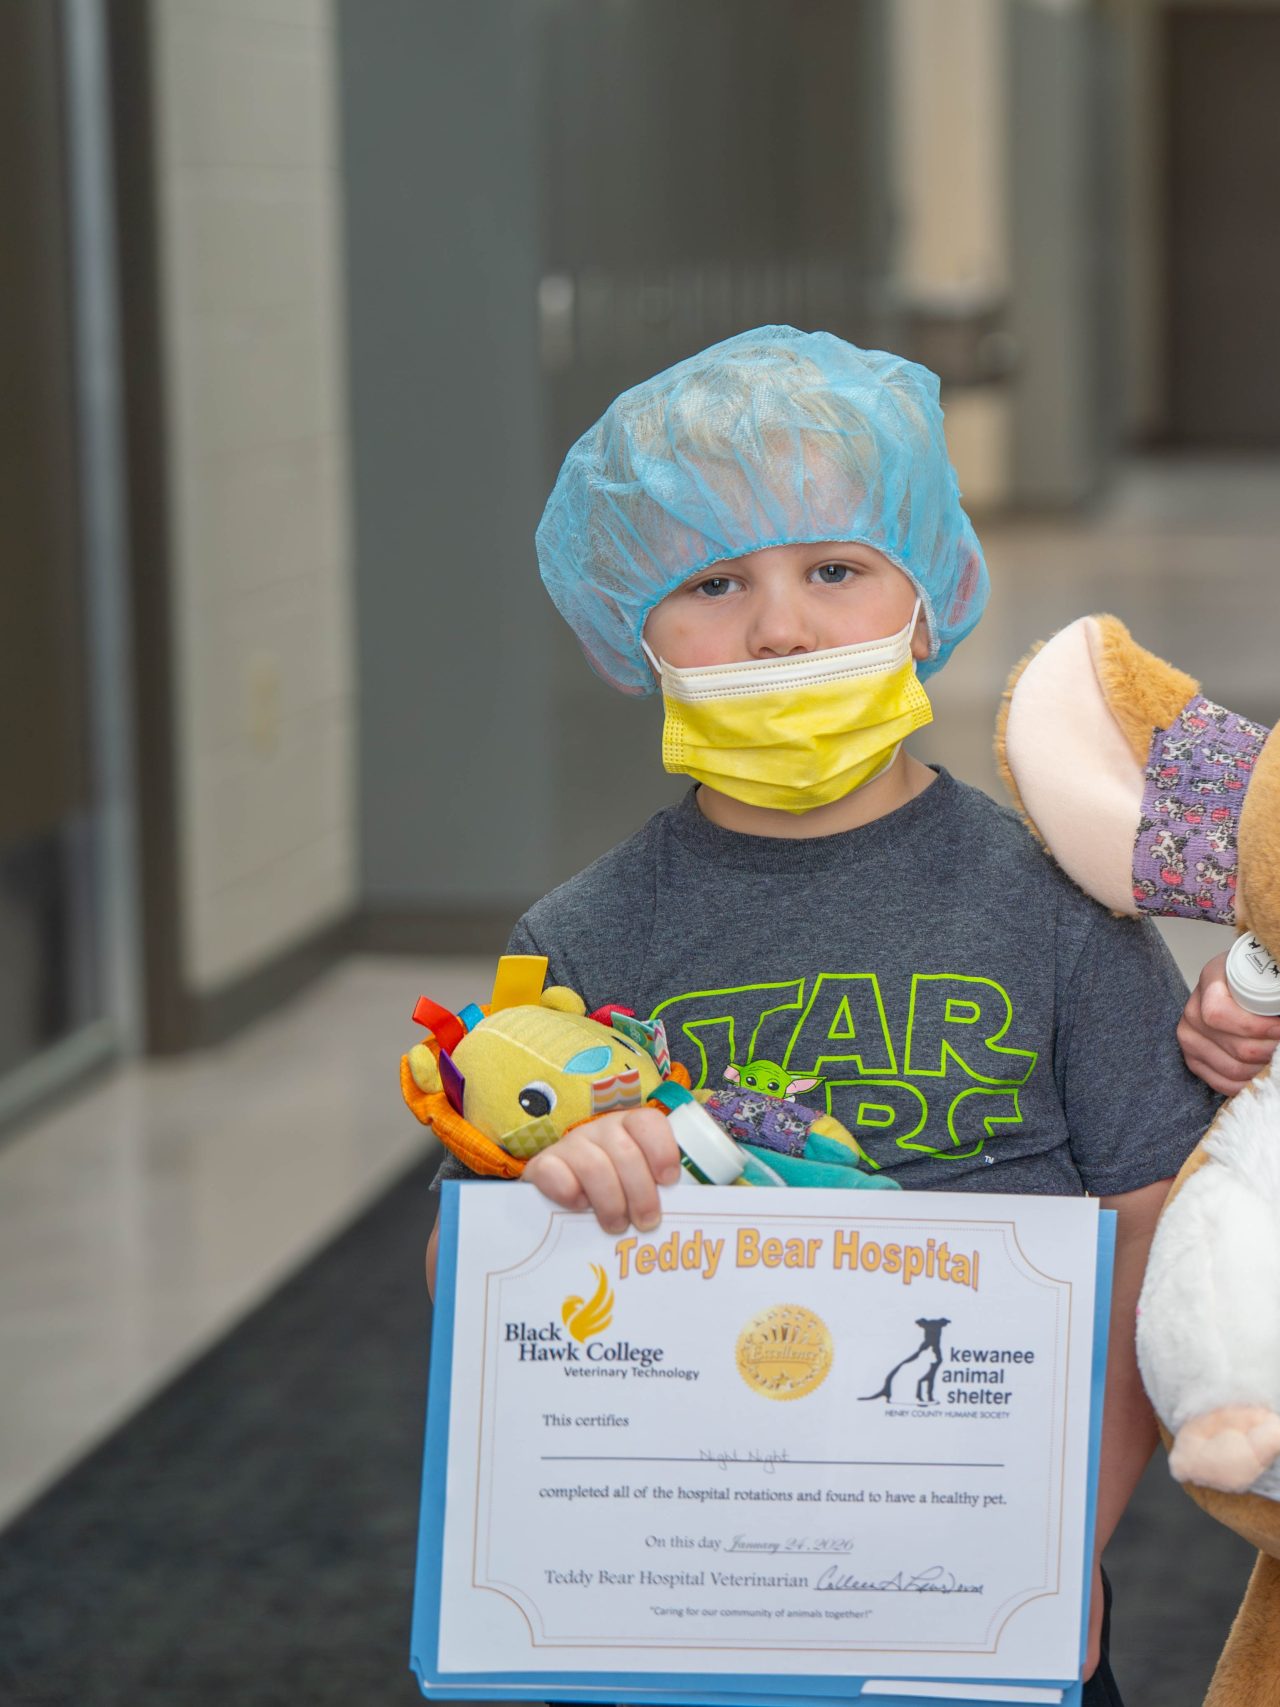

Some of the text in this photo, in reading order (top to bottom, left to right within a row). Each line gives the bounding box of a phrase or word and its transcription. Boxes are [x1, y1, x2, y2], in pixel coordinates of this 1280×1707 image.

[649, 973, 1038, 1089] STAR
[615, 1227, 980, 1292] Teddy Bear Hospital
[504, 1322, 562, 1342] Black
[518, 1342, 664, 1368] Hawk College
[950, 1347, 1035, 1364] kewanee
[563, 1366, 700, 1381] Veterinary Technology
[941, 1368, 1004, 1384] animal
[946, 1388, 1012, 1405] shelter
[542, 1414, 629, 1427] This certifies
[884, 1409, 1010, 1420] HENRY COUNTY HUMANE SOCIETY
[538, 1485, 1007, 1508] completed all of the hospital rotations and found to have a healthy pet.
[644, 1535, 666, 1548] On
[669, 1535, 695, 1549] this
[698, 1536, 722, 1552] day
[724, 1533, 780, 1554] January
[544, 1569, 809, 1589] Teddy Bear Hospital Veterinarian
[649, 1606, 684, 1618] "Caring
[686, 1606, 699, 1616] for
[702, 1609, 717, 1617] our
[720, 1608, 772, 1619] community
[774, 1607, 785, 1617] of
[787, 1608, 823, 1618] animals
